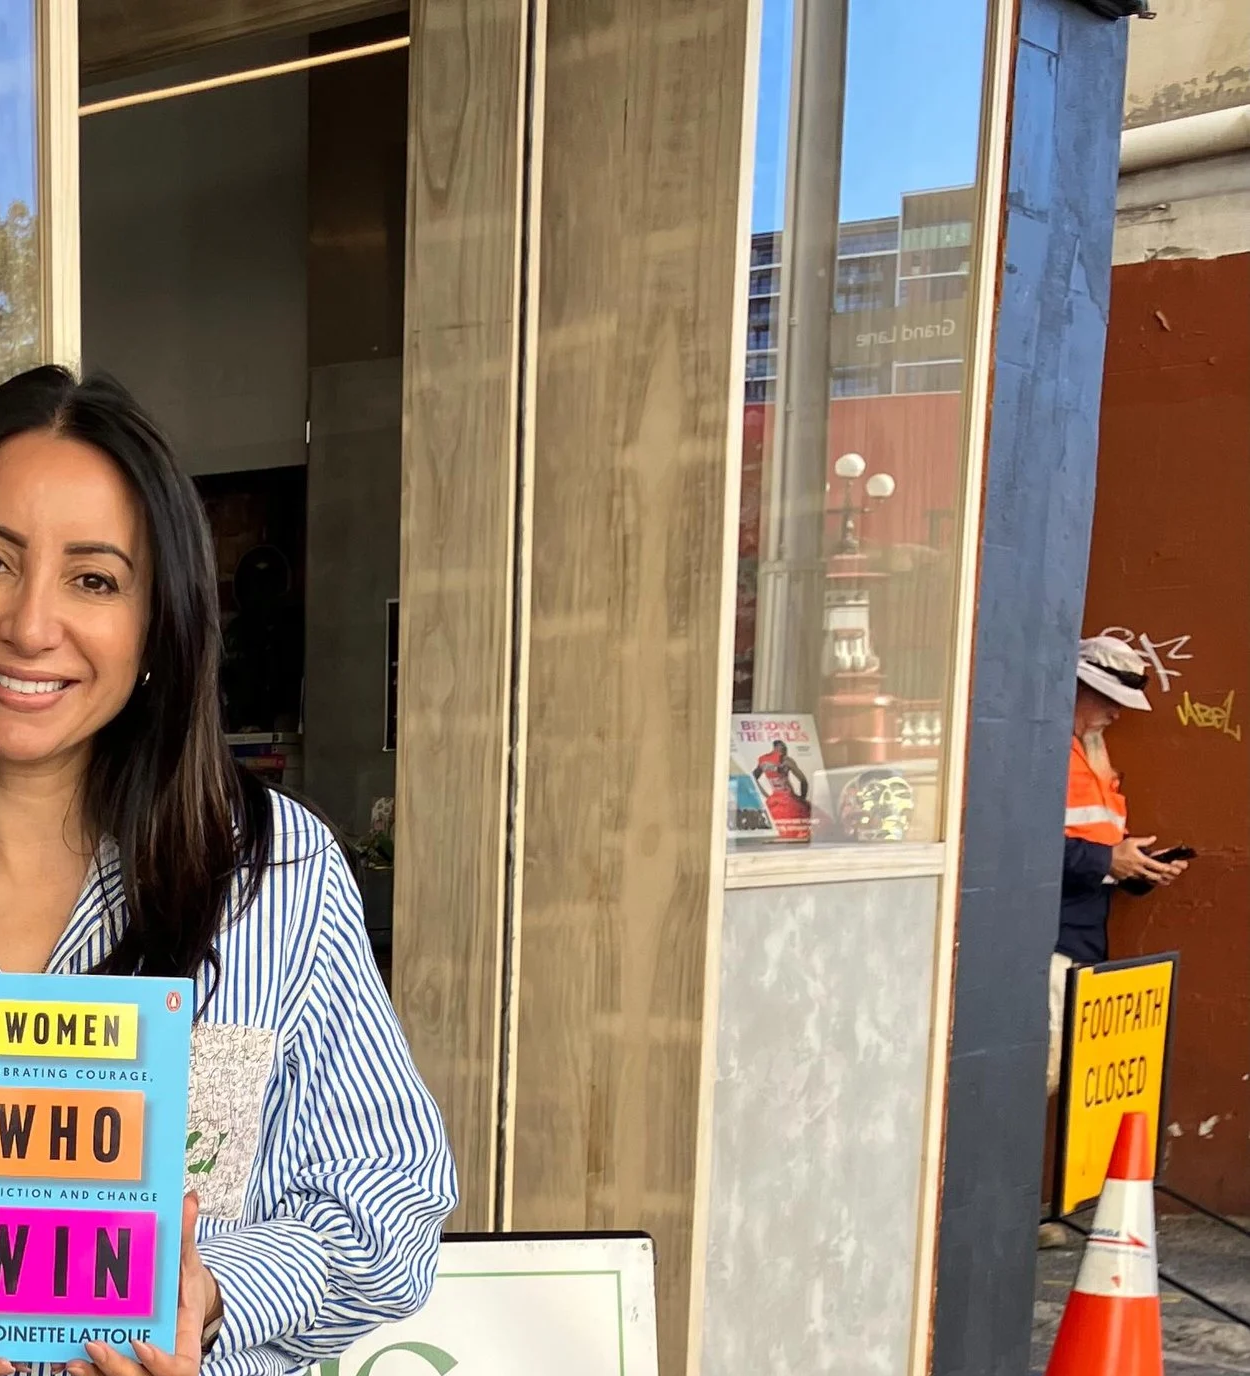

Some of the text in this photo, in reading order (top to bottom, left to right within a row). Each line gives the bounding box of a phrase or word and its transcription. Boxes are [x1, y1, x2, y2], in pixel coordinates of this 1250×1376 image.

[740, 720, 801, 731] BENDING
[1078, 986, 1165, 1044] FOOTPATH
[4, 1011, 121, 1048] WOMEN
[75, 1069, 155, 1083] COURAGE,
[1084, 1055, 1148, 1109] CLOSED
[59, 1188, 90, 1201] AND
[96, 1190, 159, 1203] CHANGE
